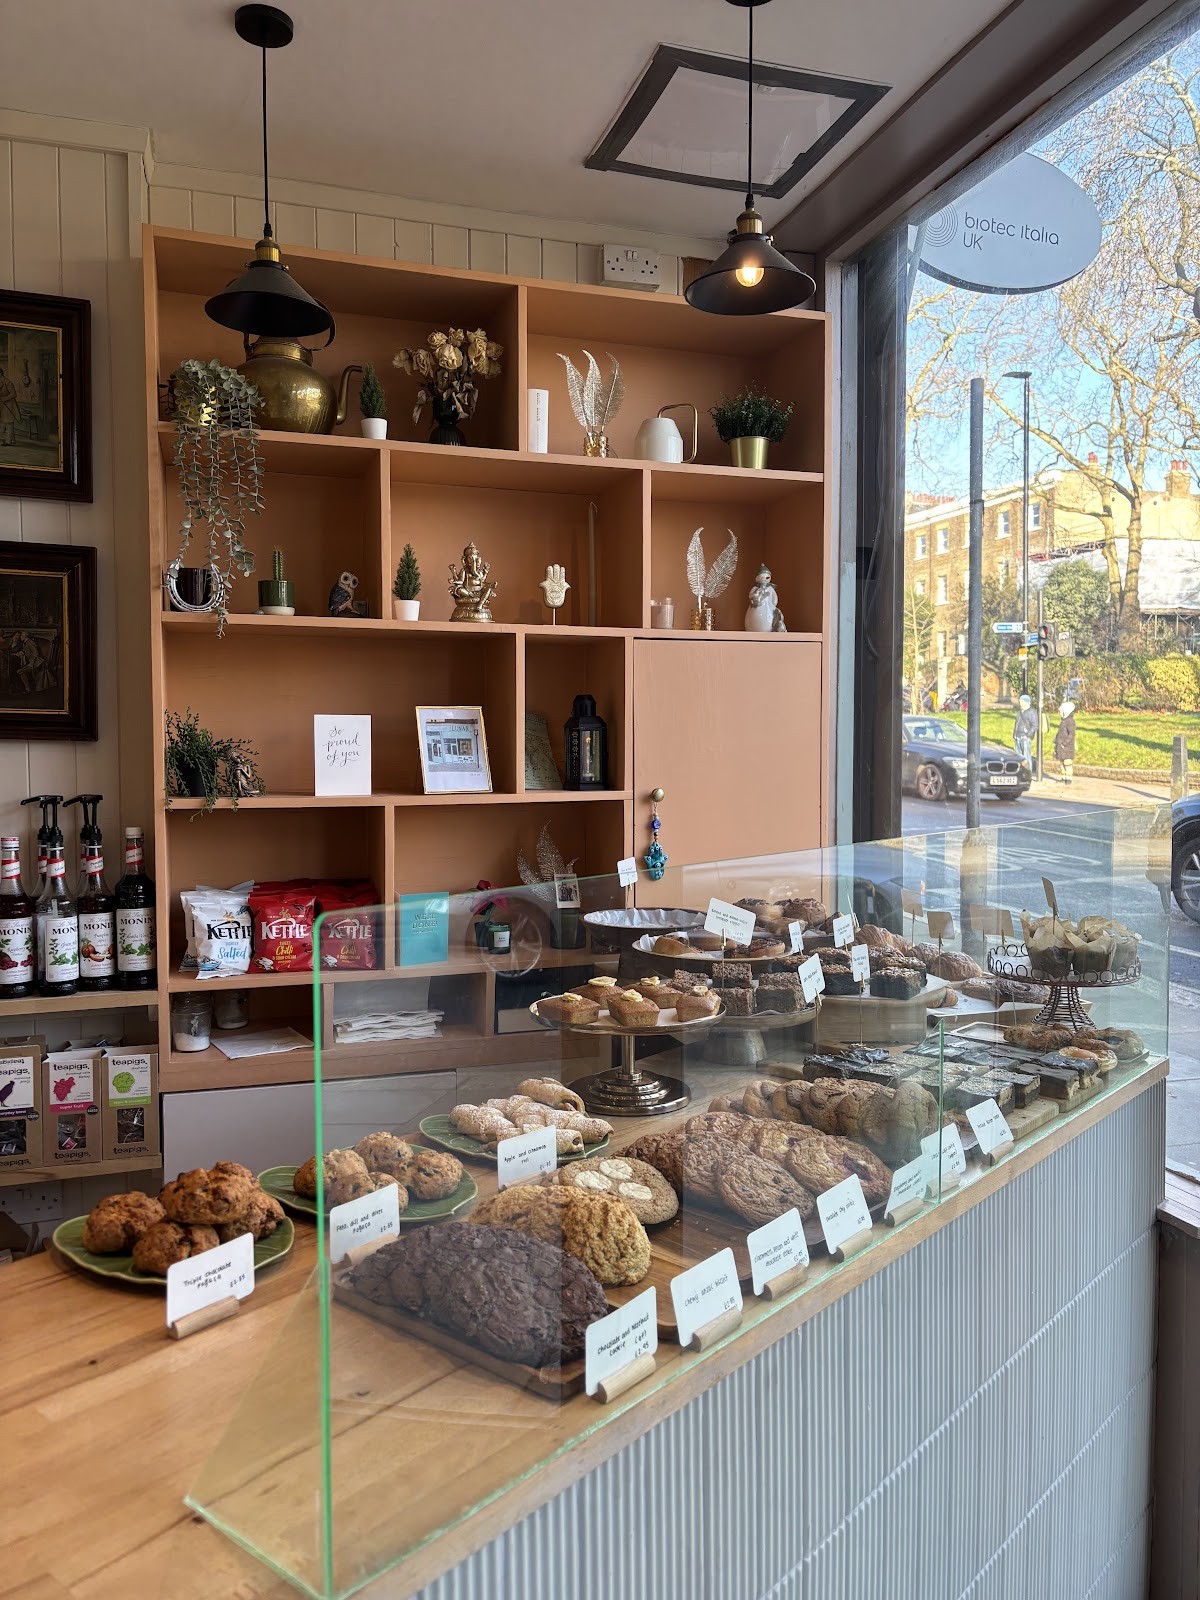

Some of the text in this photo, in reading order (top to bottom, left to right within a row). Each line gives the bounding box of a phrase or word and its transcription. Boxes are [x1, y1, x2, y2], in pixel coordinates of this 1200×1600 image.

[965, 211, 1016, 237] biotec
[963, 232, 984, 250] UK
[328, 725, 344, 737] So
[322, 732, 361, 752] proud
[326, 750, 360, 767] of you
[120, 917, 152, 925] MONIN
[414, 913, 437, 921] WELL
[52, 926, 77, 934] MON
[261, 918, 310, 940] KETTLE
[327, 918, 373, 940] KETTLE
[412, 920, 438, 929] DONE!
[218, 946, 248, 960] Salted
[518, 1150, 527, 1158] and
[361, 1214, 369, 1222] and
[621, 1327, 630, 1339] and
